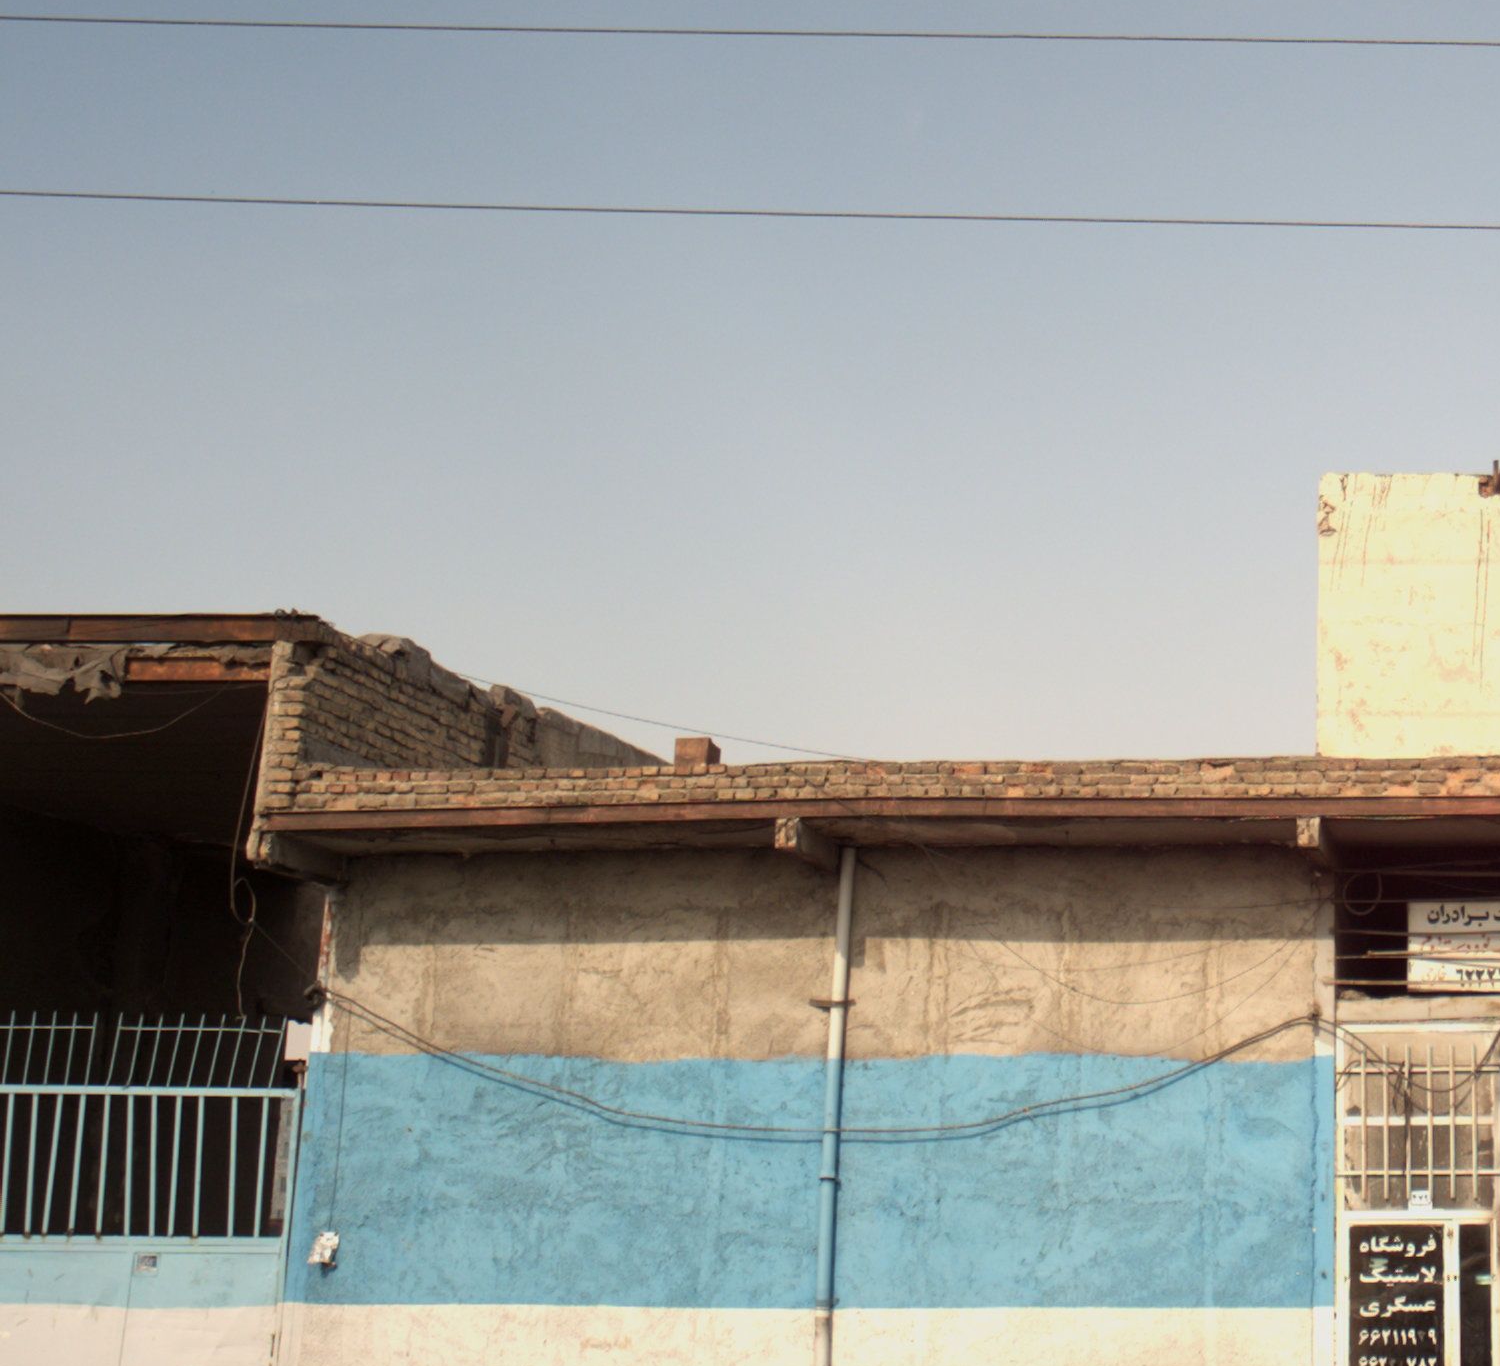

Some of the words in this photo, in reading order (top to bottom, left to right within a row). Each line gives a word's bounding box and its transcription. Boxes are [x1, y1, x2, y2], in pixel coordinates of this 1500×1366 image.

[1427, 903, 1489, 927] برادران
[1360, 1234, 1437, 1258] فروشگاه
[1360, 1266, 1437, 1287] لاستیک
